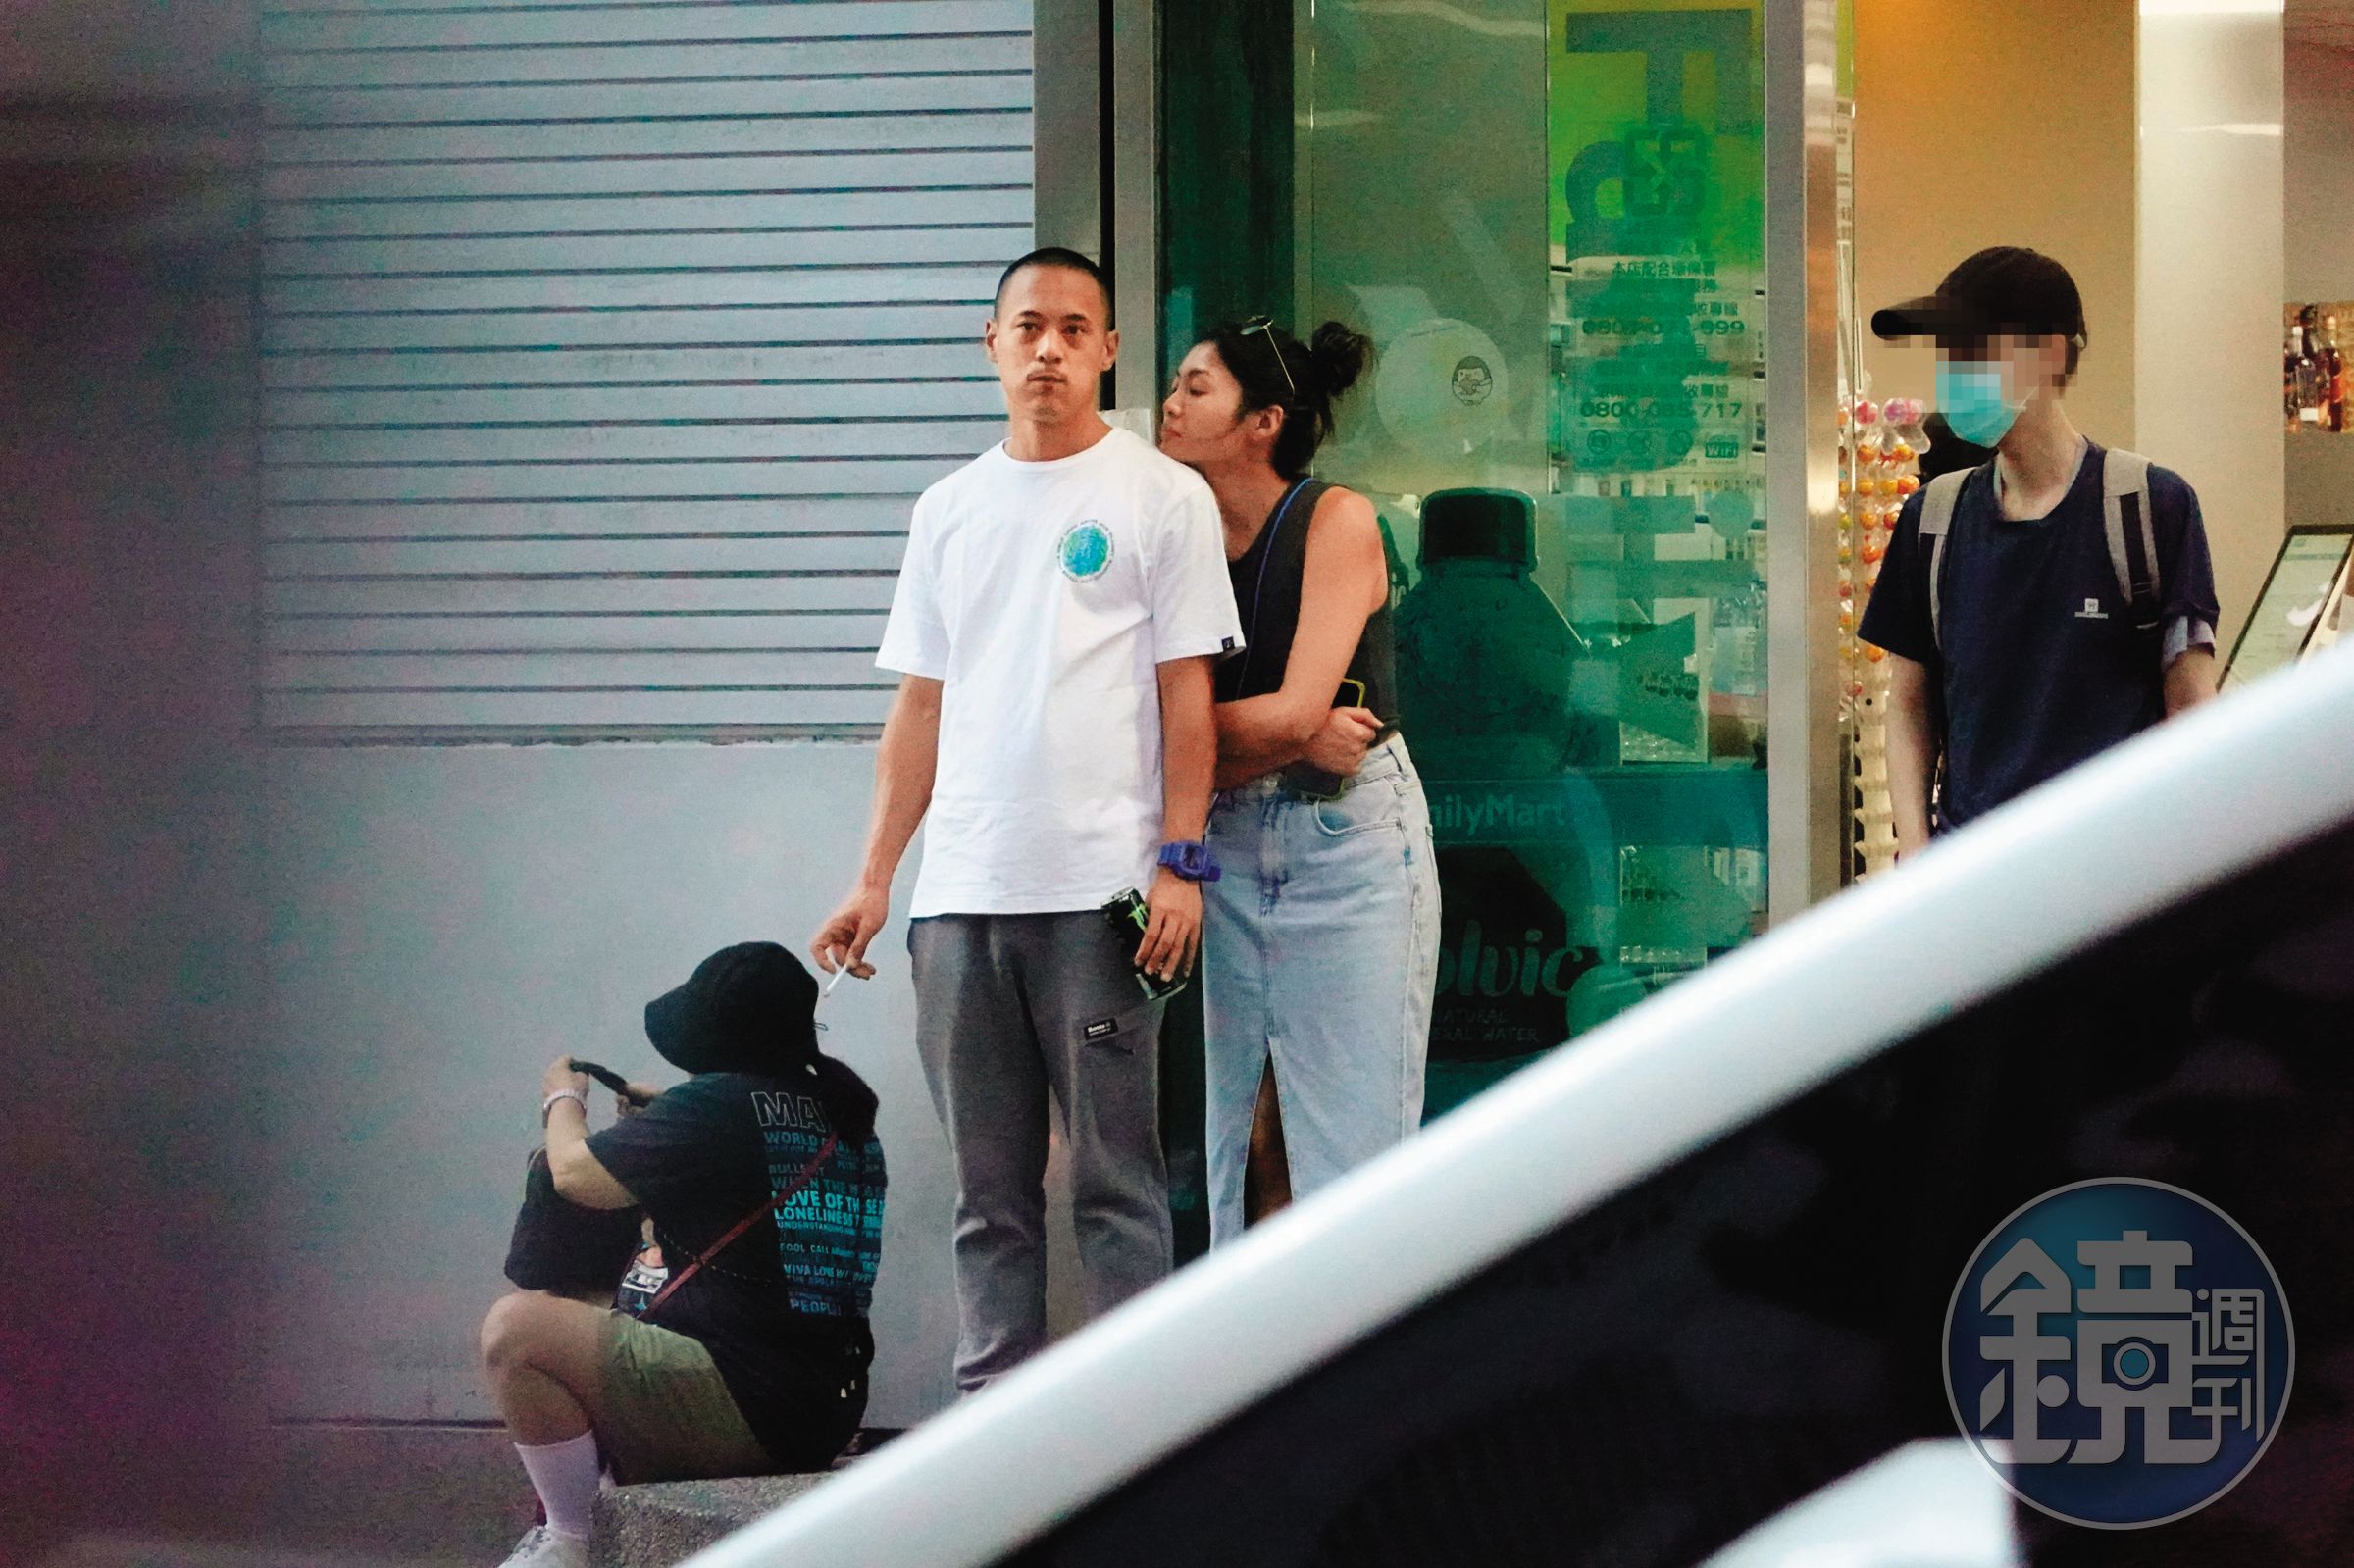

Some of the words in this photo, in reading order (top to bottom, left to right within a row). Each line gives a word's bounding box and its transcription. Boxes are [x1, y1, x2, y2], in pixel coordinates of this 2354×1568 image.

[1429, 793, 1567, 836] ilyMart
[763, 1131, 817, 1146] WORLD
[825, 1192, 844, 1210] OF
